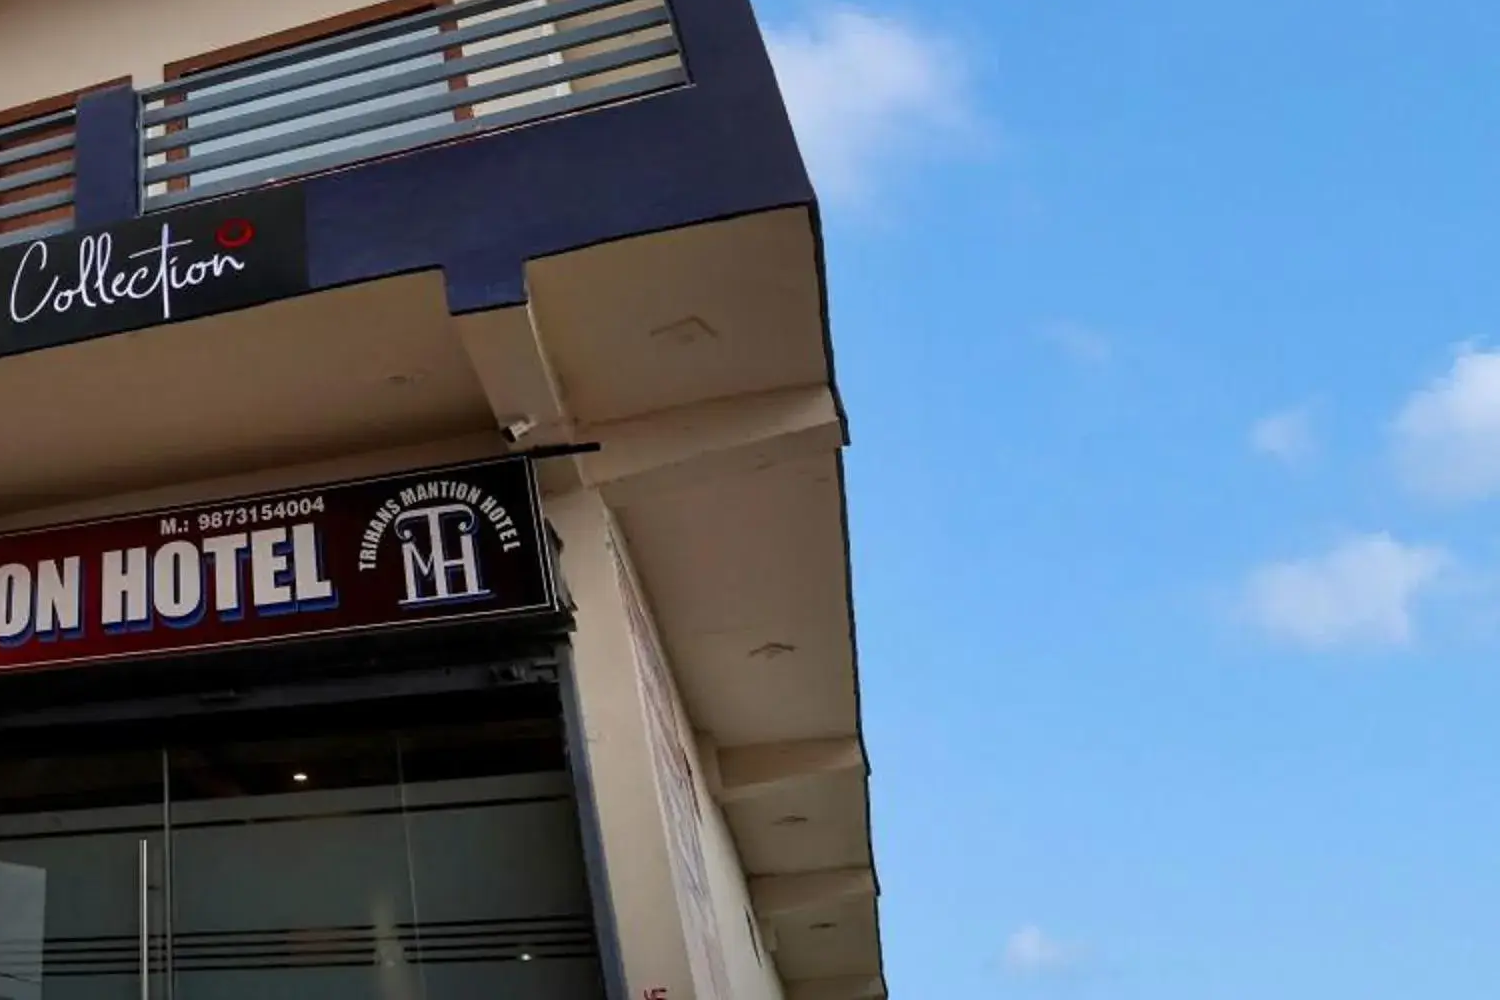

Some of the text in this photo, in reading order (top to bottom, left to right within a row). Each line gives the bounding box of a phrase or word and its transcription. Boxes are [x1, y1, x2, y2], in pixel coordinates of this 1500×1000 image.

[10, 223, 245, 323] Collection
[197, 496, 325, 531] 9873154004
[358, 480, 521, 572] TRIHANS MANTION HOTEL
[101, 524, 331, 625] HOTEL
